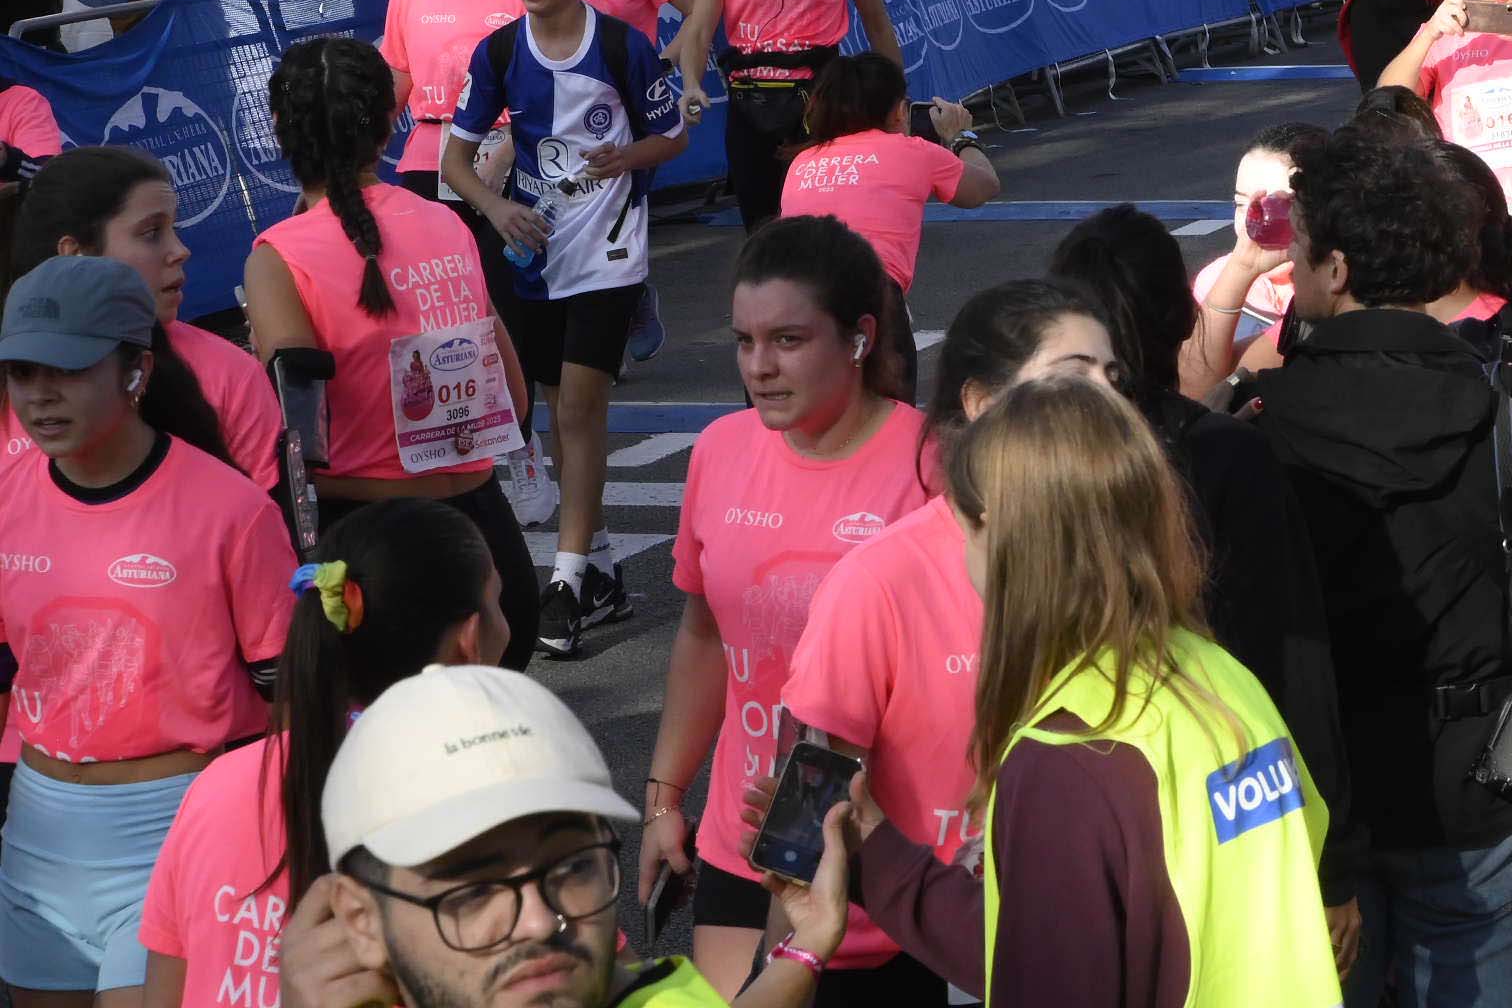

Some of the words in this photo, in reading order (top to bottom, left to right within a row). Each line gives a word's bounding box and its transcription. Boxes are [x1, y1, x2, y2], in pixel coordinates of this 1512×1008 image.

[421, 14, 456, 24] OYSHO
[739, 22, 758, 41] TU
[422, 85, 445, 105] TU
[795, 153, 879, 176] CARRERA
[804, 165, 827, 178] DE
[834, 164, 859, 175] LA
[517, 174, 560, 195] RIYAD
[798, 175, 860, 192] MUJER
[390, 255, 475, 292] CARRERA
[415, 289, 443, 312] DE
[450, 280, 473, 302] LA
[419, 303, 480, 334] MUJER
[433, 350, 477, 367] ASTURIANA
[437, 379, 477, 405] 016
[446, 406, 470, 422] 3096
[410, 429, 446, 442] CARRERA
[410, 448, 447, 464] OYSHO
[725, 507, 783, 529] OYSHO
[0, 553, 52, 573] YSHO
[111, 567, 171, 581] ASTURIANA
[444, 741, 459, 756] la
[460, 730, 510, 751] bonne
